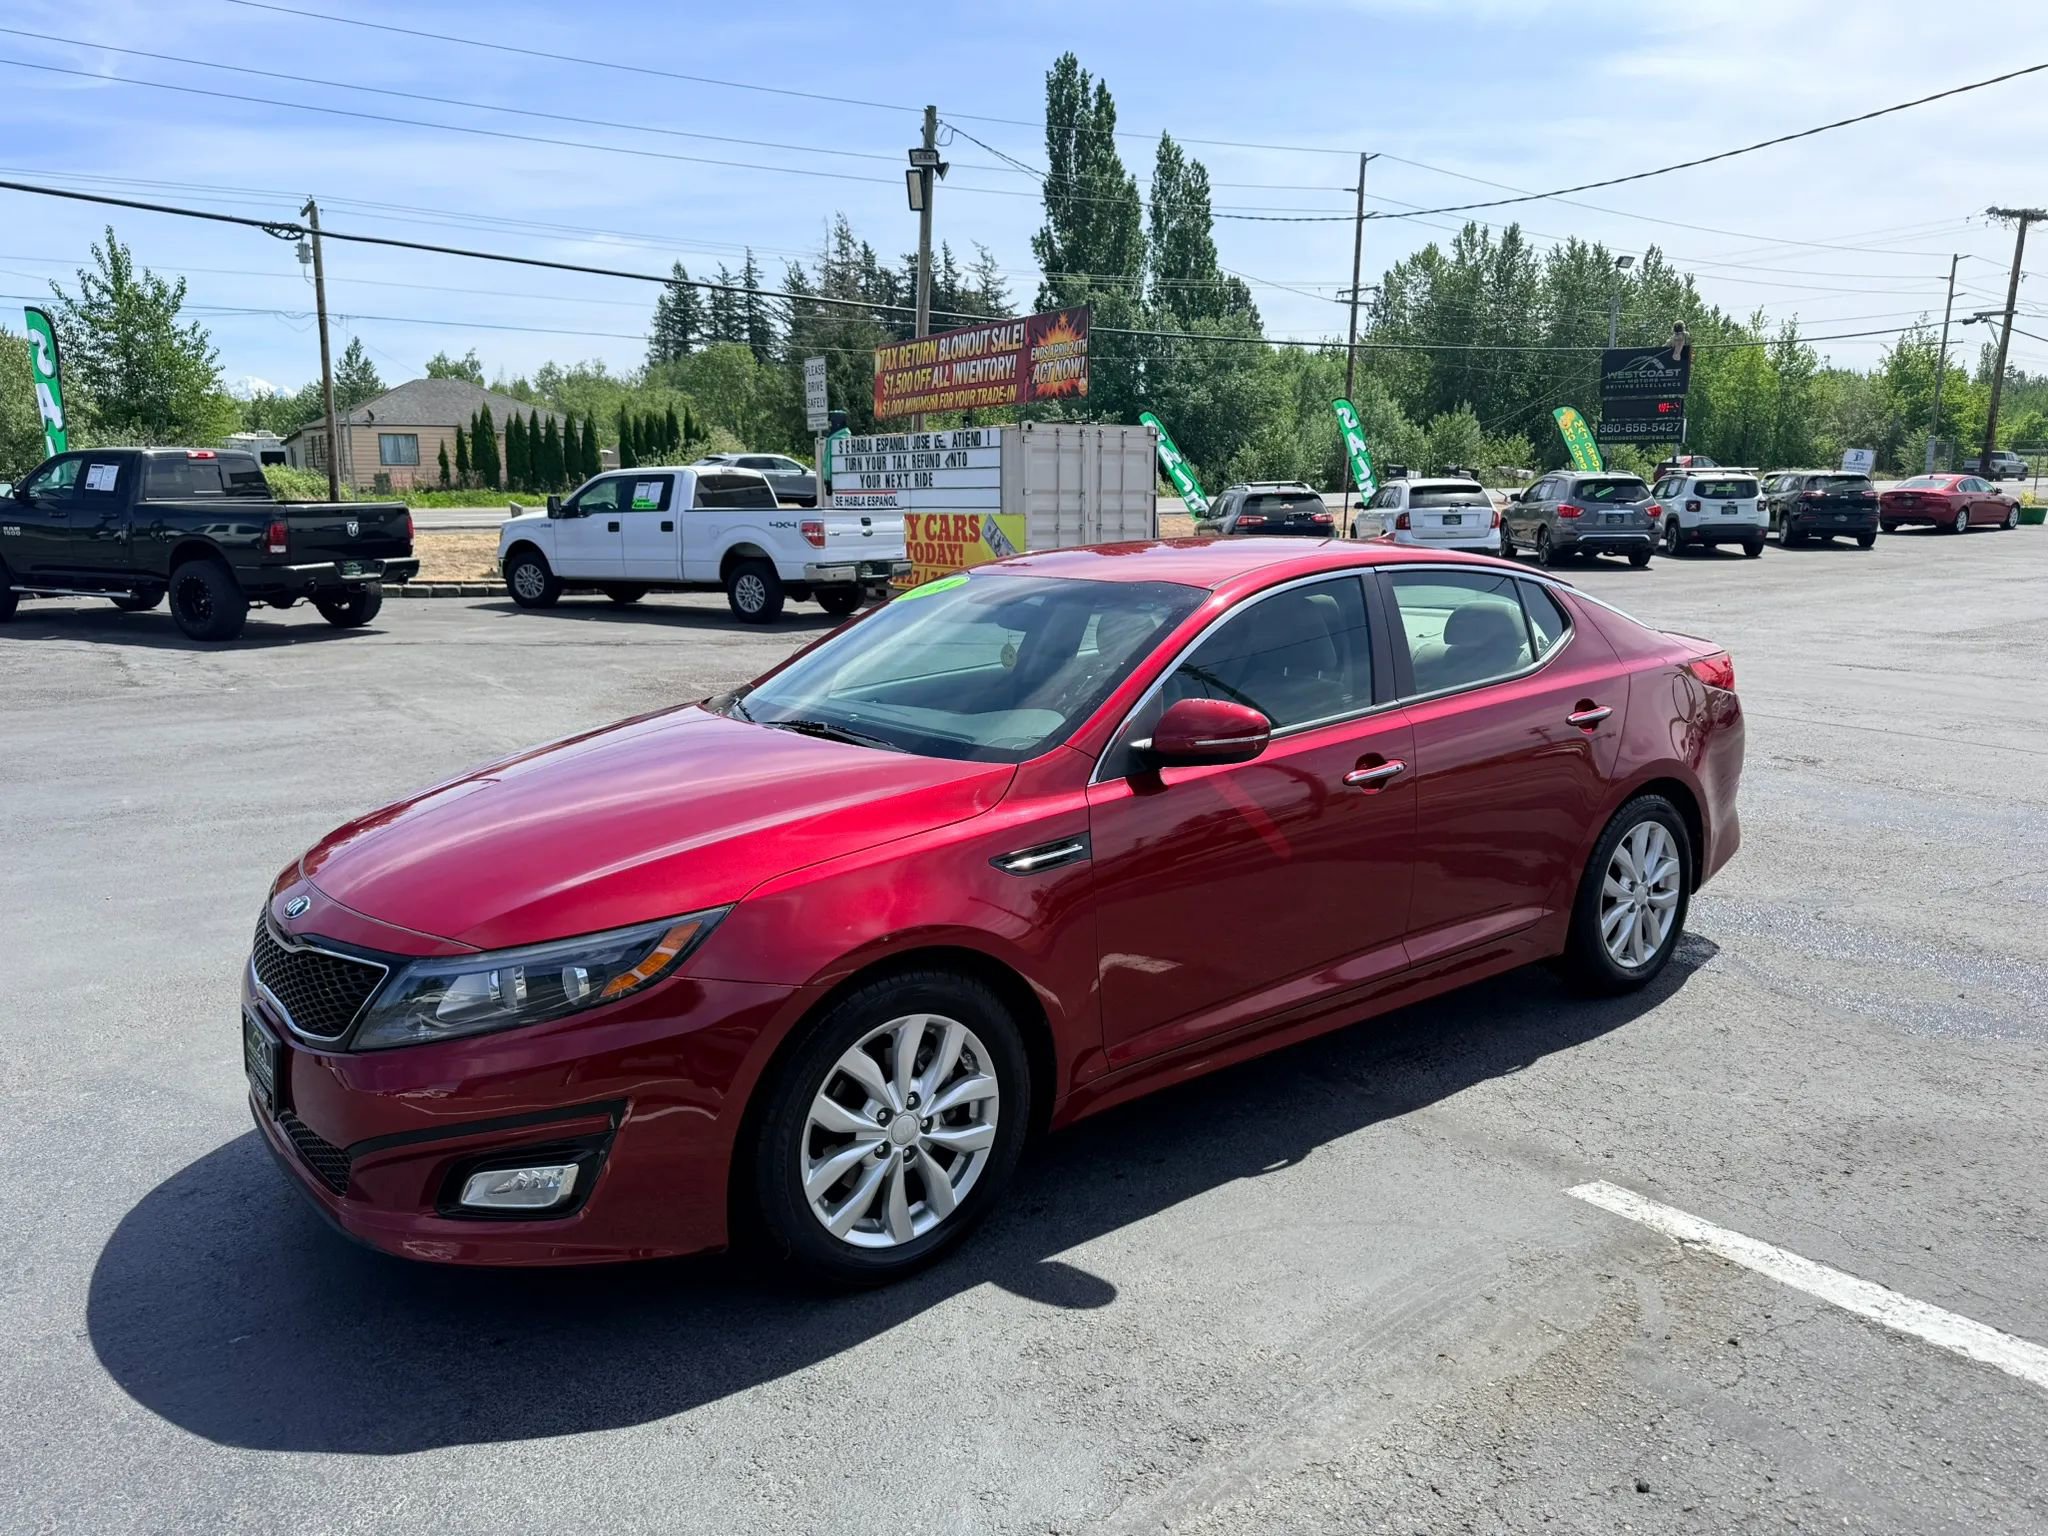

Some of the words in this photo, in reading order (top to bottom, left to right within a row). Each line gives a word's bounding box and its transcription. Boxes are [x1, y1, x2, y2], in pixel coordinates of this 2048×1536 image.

[880, 347, 898, 372] TAX
[898, 340, 938, 369] RETURN
[938, 329, 990, 361] BLOWOUT
[991, 323, 1024, 355] SALE!
[1030, 345, 1049, 361] ENDS
[1049, 341, 1070, 358] APRIL
[1069, 337, 1088, 355] 24TH
[806, 364, 825, 376] PLEASE
[883, 368, 914, 397] $1,500
[914, 367, 931, 391] OFF
[931, 364, 950, 388] ALL
[952, 354, 1017, 386] INVENTORY!
[1031, 361, 1054, 384] ACT
[1055, 355, 1086, 381] NOW!
[1607, 368, 1682, 379] WESTCOAST
[807, 380, 824, 392] DRIVE
[938, 389, 953, 409] FOR
[953, 386, 977, 407] YOUR
[977, 383, 1017, 405] TRADE-IN
[807, 397, 826, 408] SAFELY
[1599, 422, 1681, 433] 360-656-5427
[850, 437, 872, 453] HABLA
[912, 433, 930, 450] JOSE
[952, 430, 982, 448] ATIEND
[844, 455, 863, 471] TURN
[866, 454, 887, 471] YOUR
[892, 454, 907, 470] TAX
[912, 453, 941, 469] REFUND
[859, 473, 882, 489] YOUR
[885, 472, 910, 489] NEXT
[914, 471, 934, 488] RIDE
[834, 496, 844, 507] SE
[844, 495, 866, 507] HABLA
[867, 493, 898, 507] ESPAÑOL
[924, 513, 981, 543] CARS
[906, 541, 964, 566] TODAY!
